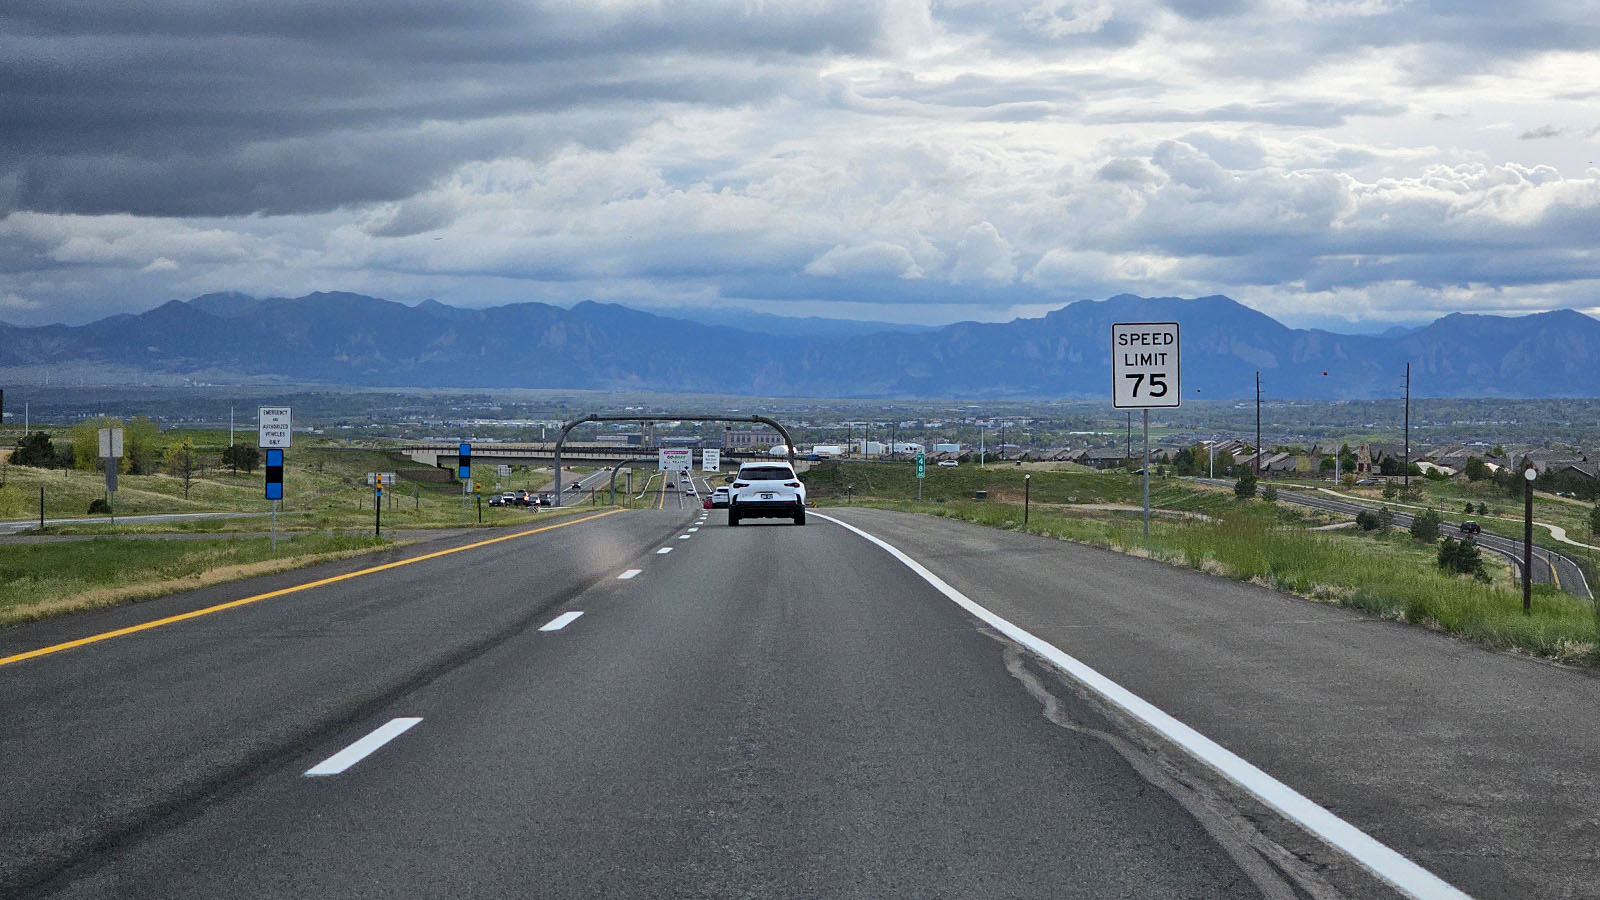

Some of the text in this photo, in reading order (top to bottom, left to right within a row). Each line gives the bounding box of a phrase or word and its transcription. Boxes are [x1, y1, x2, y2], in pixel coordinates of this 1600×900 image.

[1119, 333, 1174, 346] SPEED
[1125, 353, 1167, 366] LIMIT
[1126, 374, 1168, 397] 75
